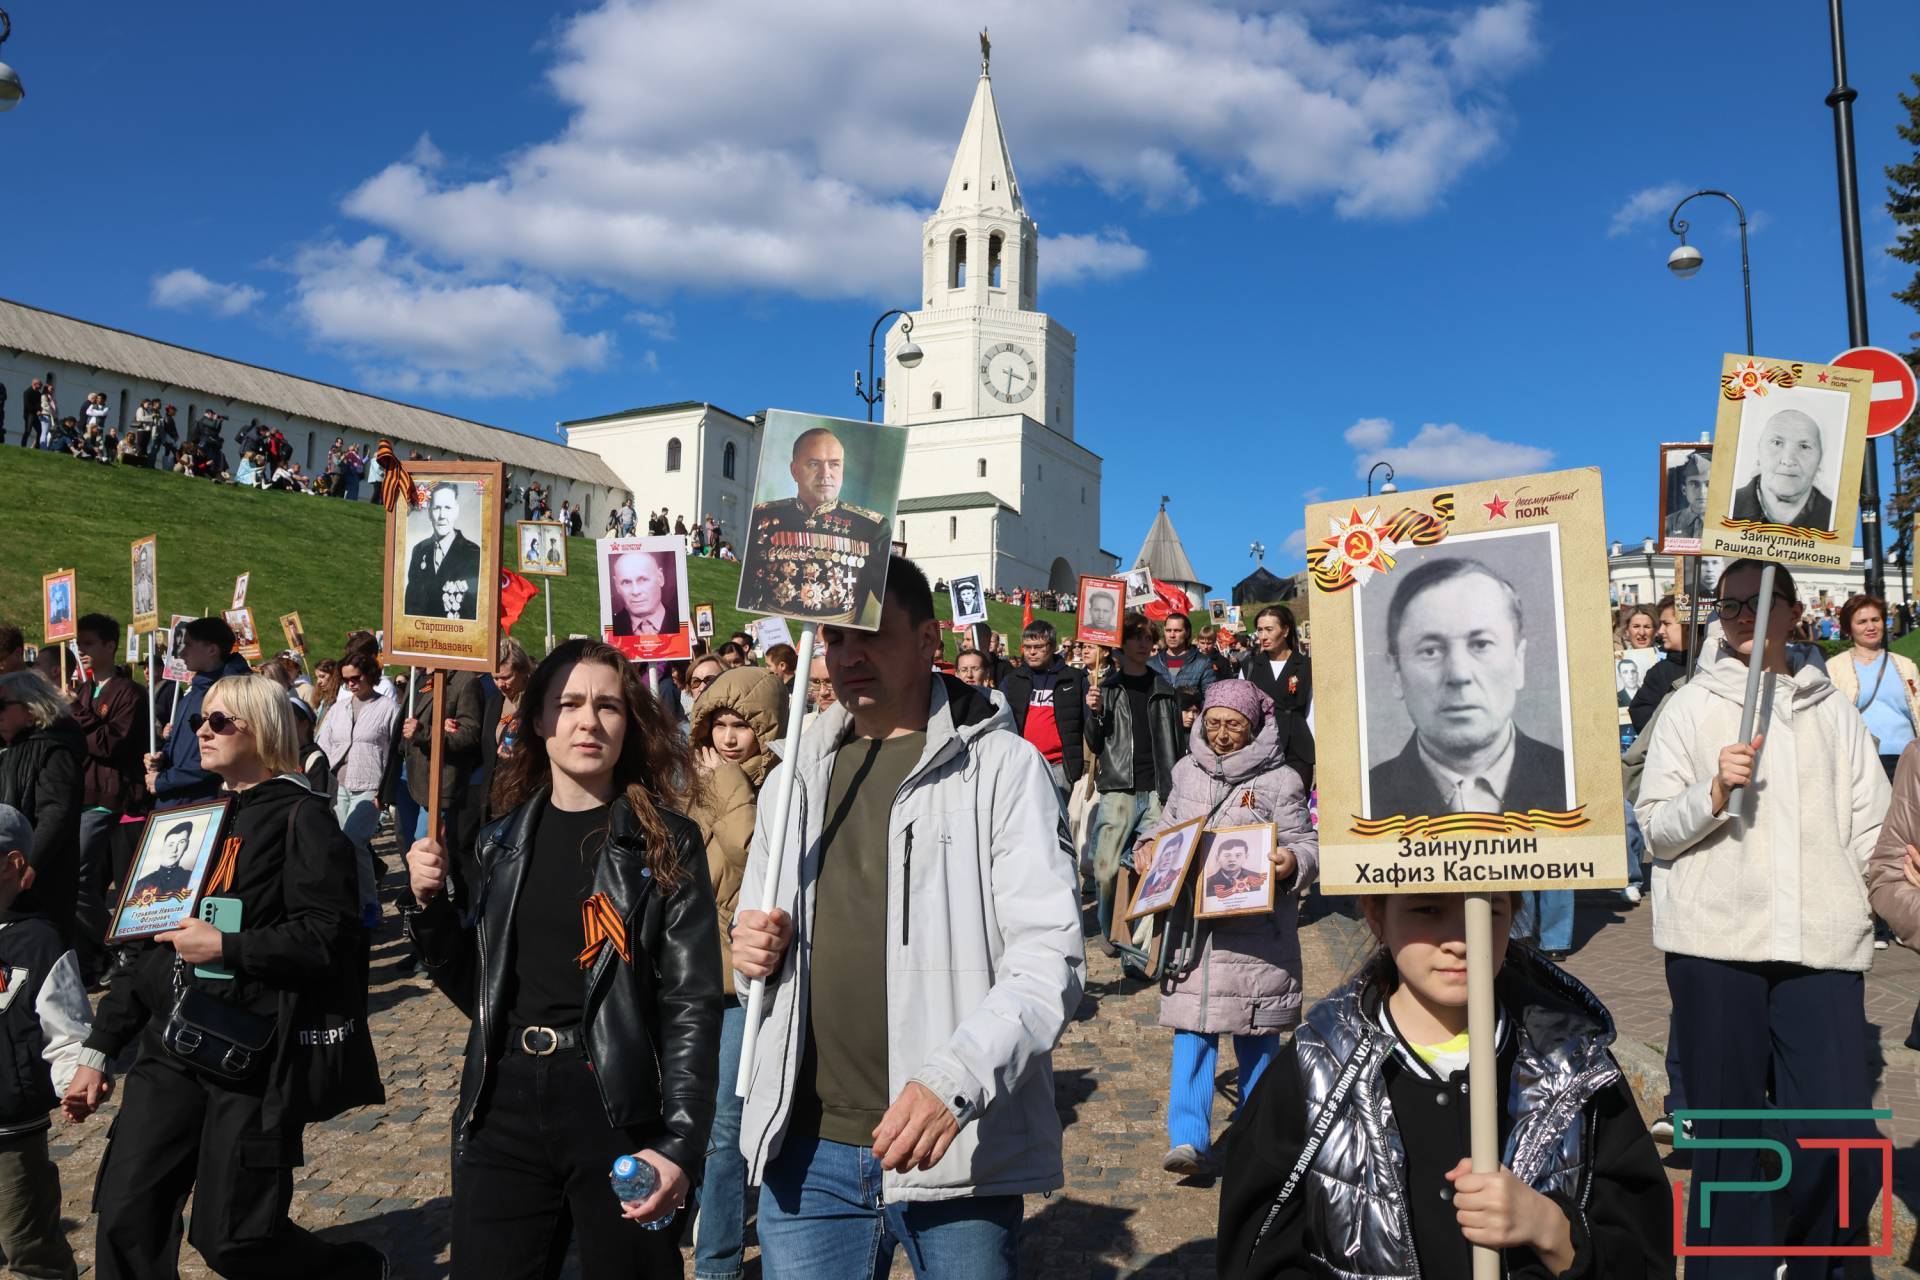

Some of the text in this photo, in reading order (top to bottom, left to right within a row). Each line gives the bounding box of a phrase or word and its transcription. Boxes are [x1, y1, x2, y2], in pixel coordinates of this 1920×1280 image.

[1515, 506, 1549, 519] ПОЛК
[1715, 539, 1763, 556] Рашида
[1766, 545, 1841, 565] Ситдиковна
[414, 619, 464, 633] Старшинов
[431, 638, 473, 653] Иванович
[1398, 835, 1538, 861] Зайнуллин
[1355, 860, 1595, 888] Хафиз Касымович
[118, 922, 168, 934] БЕССМЕРТНЫЙ
[1354, 1037, 1372, 1064] STAY
[1333, 1063, 1359, 1103] UNIQUE
[1293, 1137, 1321, 1175] UNIQUE
